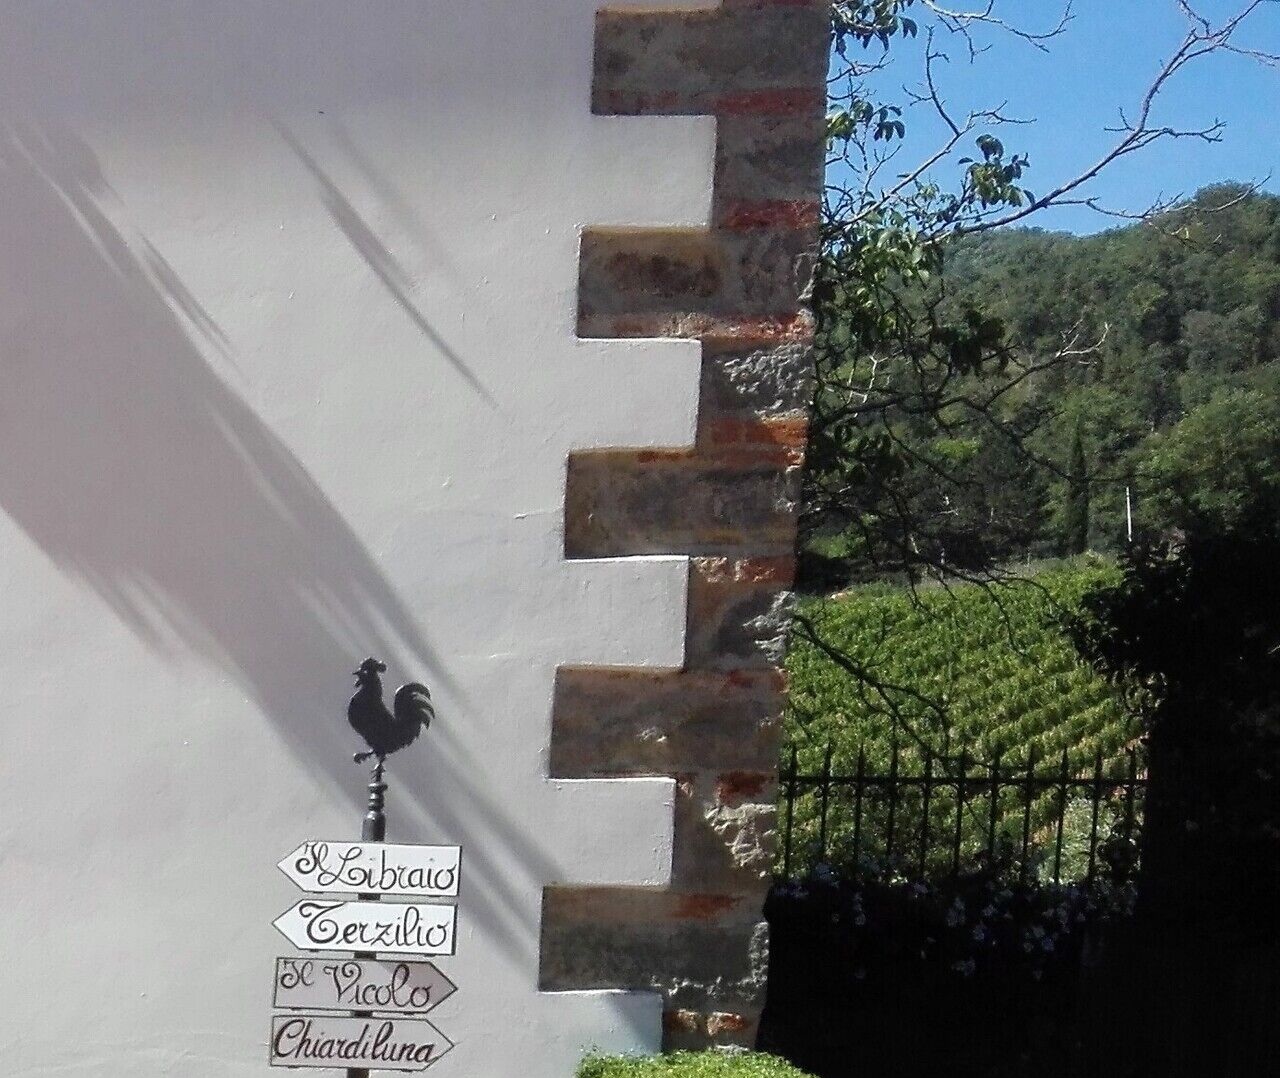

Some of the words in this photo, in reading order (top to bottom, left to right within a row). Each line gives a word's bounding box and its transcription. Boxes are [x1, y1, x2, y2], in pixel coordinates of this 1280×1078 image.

[318, 846, 456, 890] Libraio
[298, 901, 449, 946] Terzilio
[325, 962, 433, 1008] Vicolo
[273, 1019, 439, 1063] Chiardiluna
